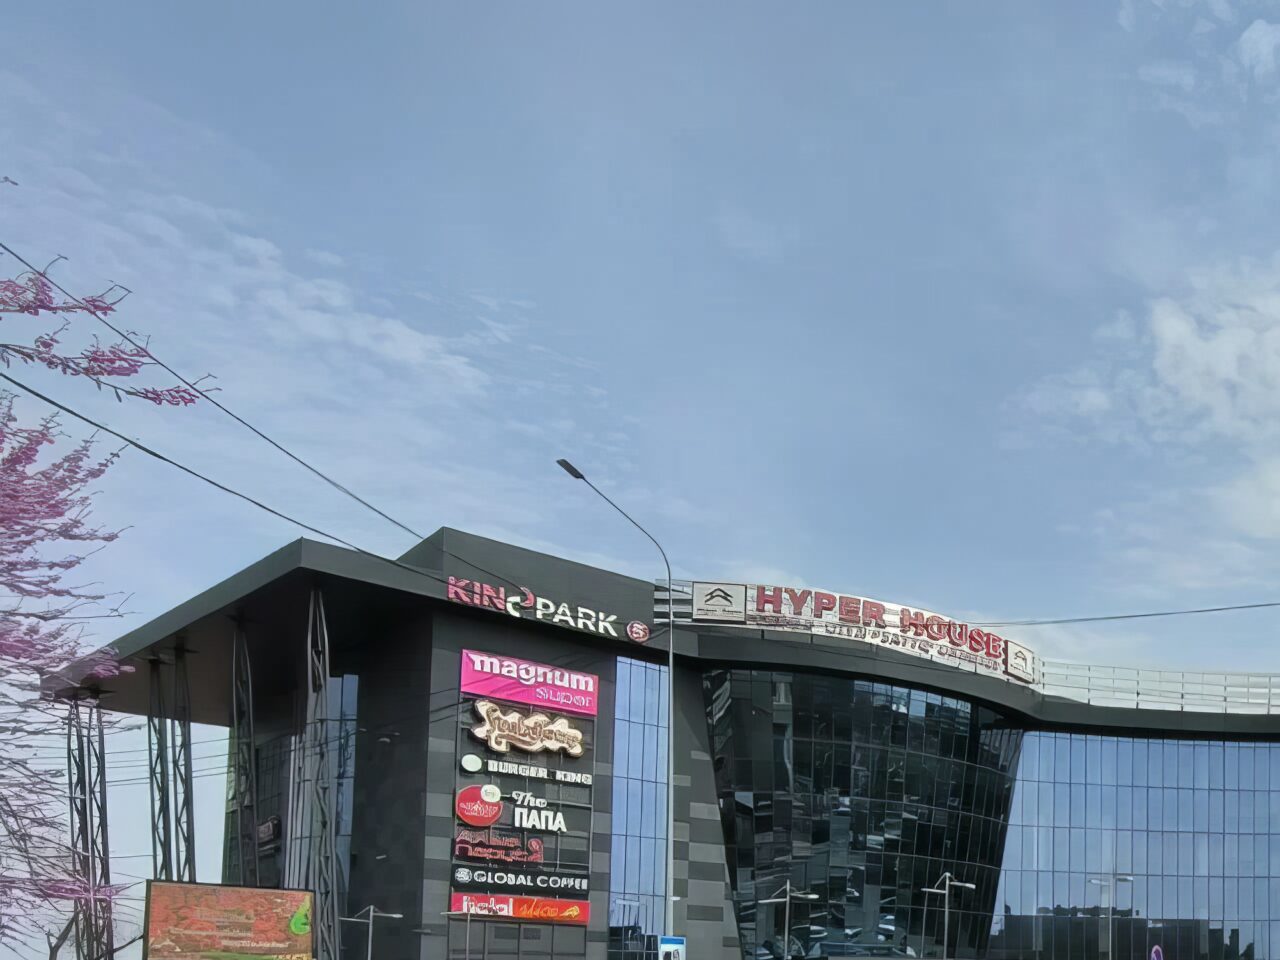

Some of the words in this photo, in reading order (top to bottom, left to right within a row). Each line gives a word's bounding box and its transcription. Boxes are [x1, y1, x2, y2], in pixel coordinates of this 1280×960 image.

[447, 575, 619, 637] KINOPARK
[755, 585, 886, 629] HYPER
[899, 607, 1004, 660] HOUSE
[471, 653, 595, 693] magnum
[514, 807, 568, 833] ПАПА
[473, 870, 534, 887] GLOBAL
[536, 876, 588, 891] COFFEE
